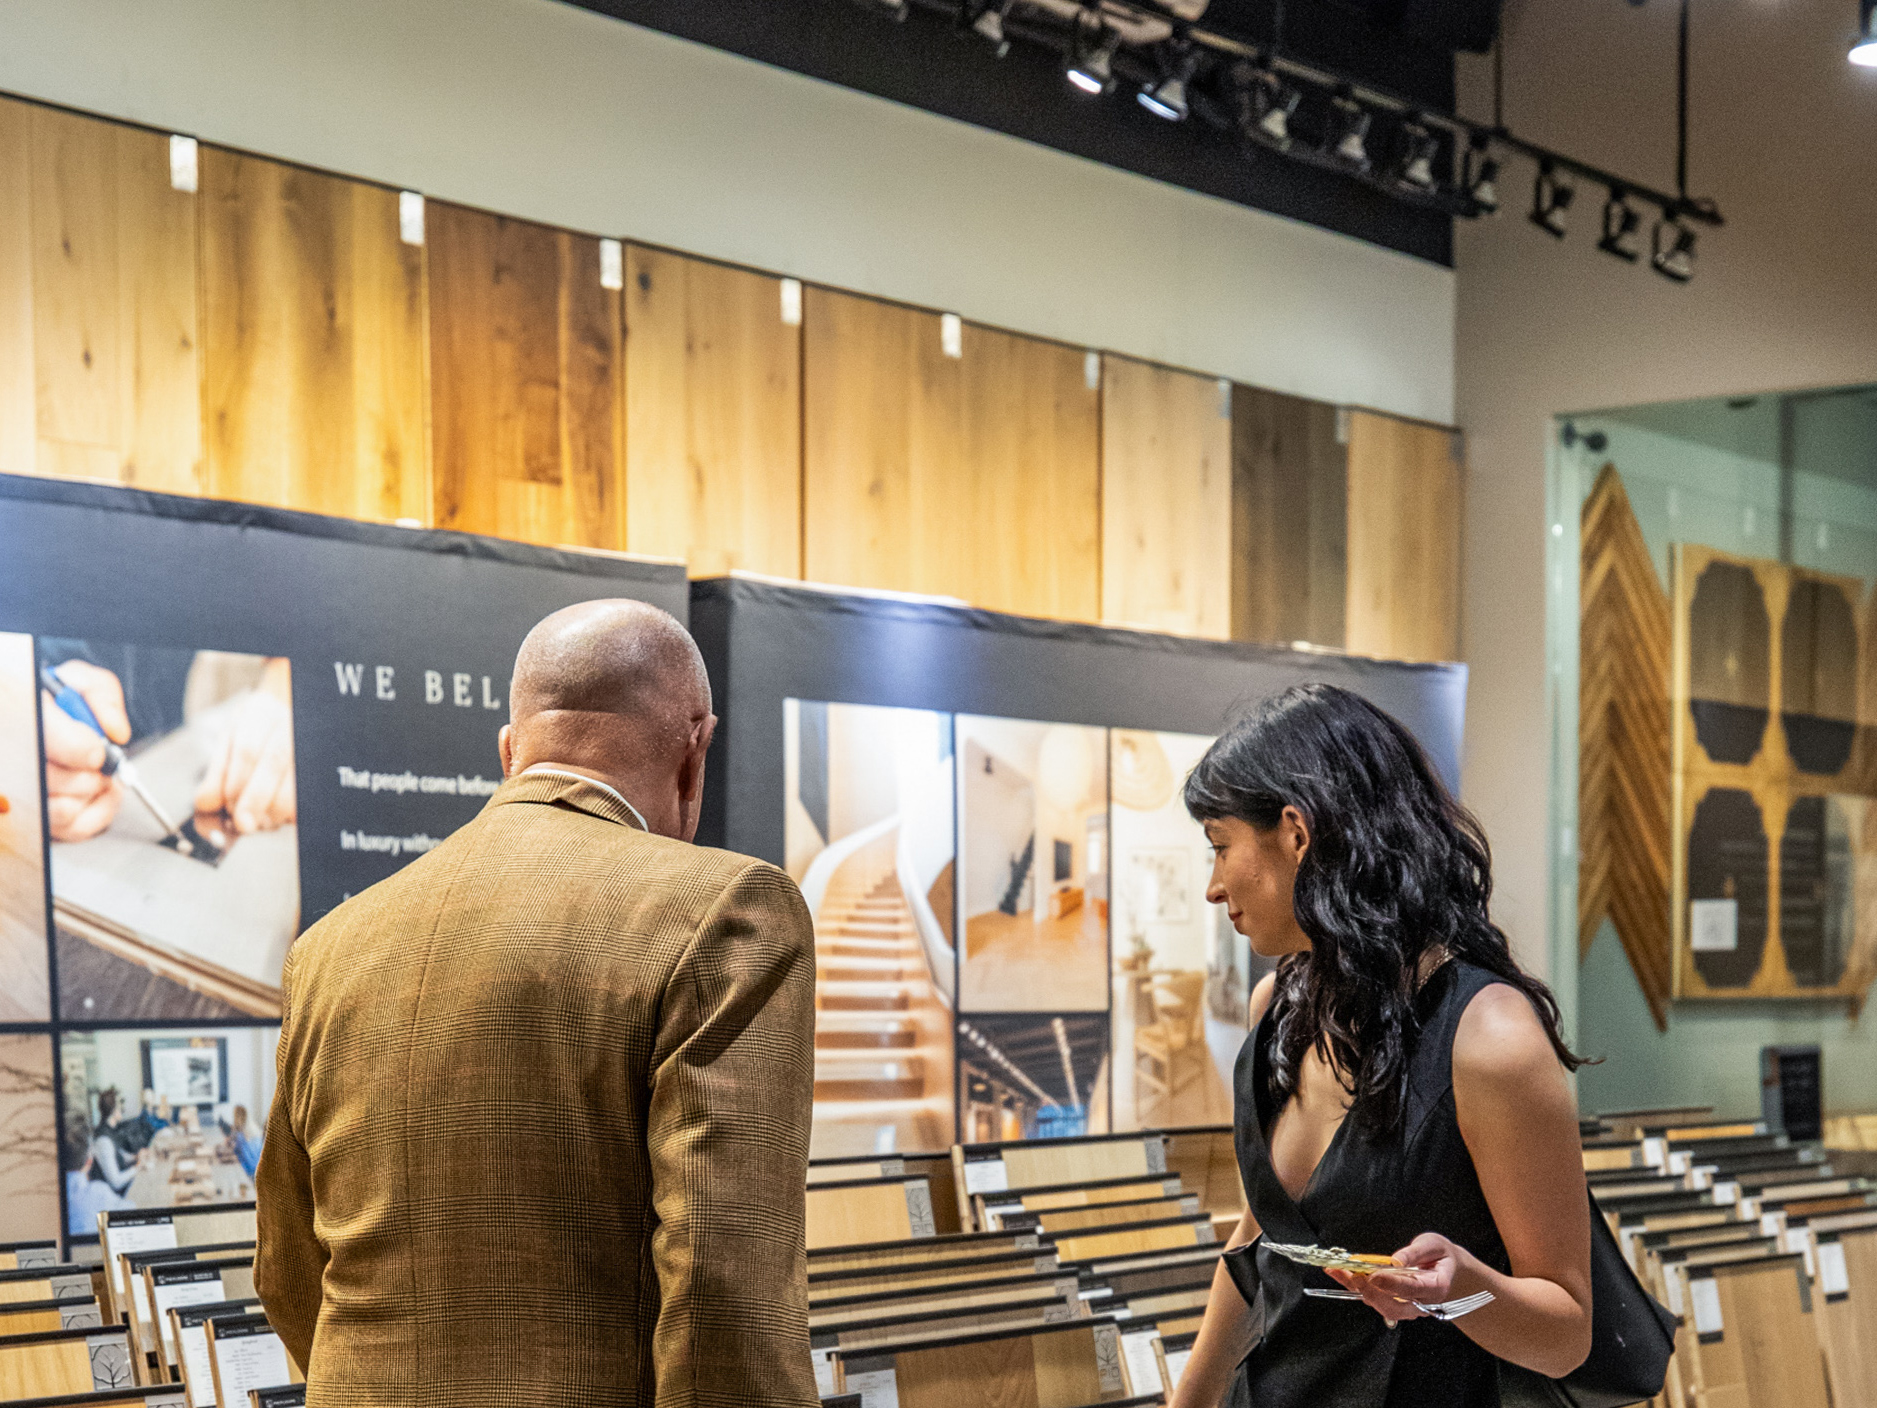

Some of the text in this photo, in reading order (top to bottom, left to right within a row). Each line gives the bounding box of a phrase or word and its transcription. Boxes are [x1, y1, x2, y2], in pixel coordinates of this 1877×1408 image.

[334, 661, 501, 710] WE BEL
[337, 766, 370, 789] That
[371, 770, 418, 795] people
[419, 776, 457, 794] come
[340, 830, 356, 850] In
[356, 830, 400, 857] luxury
